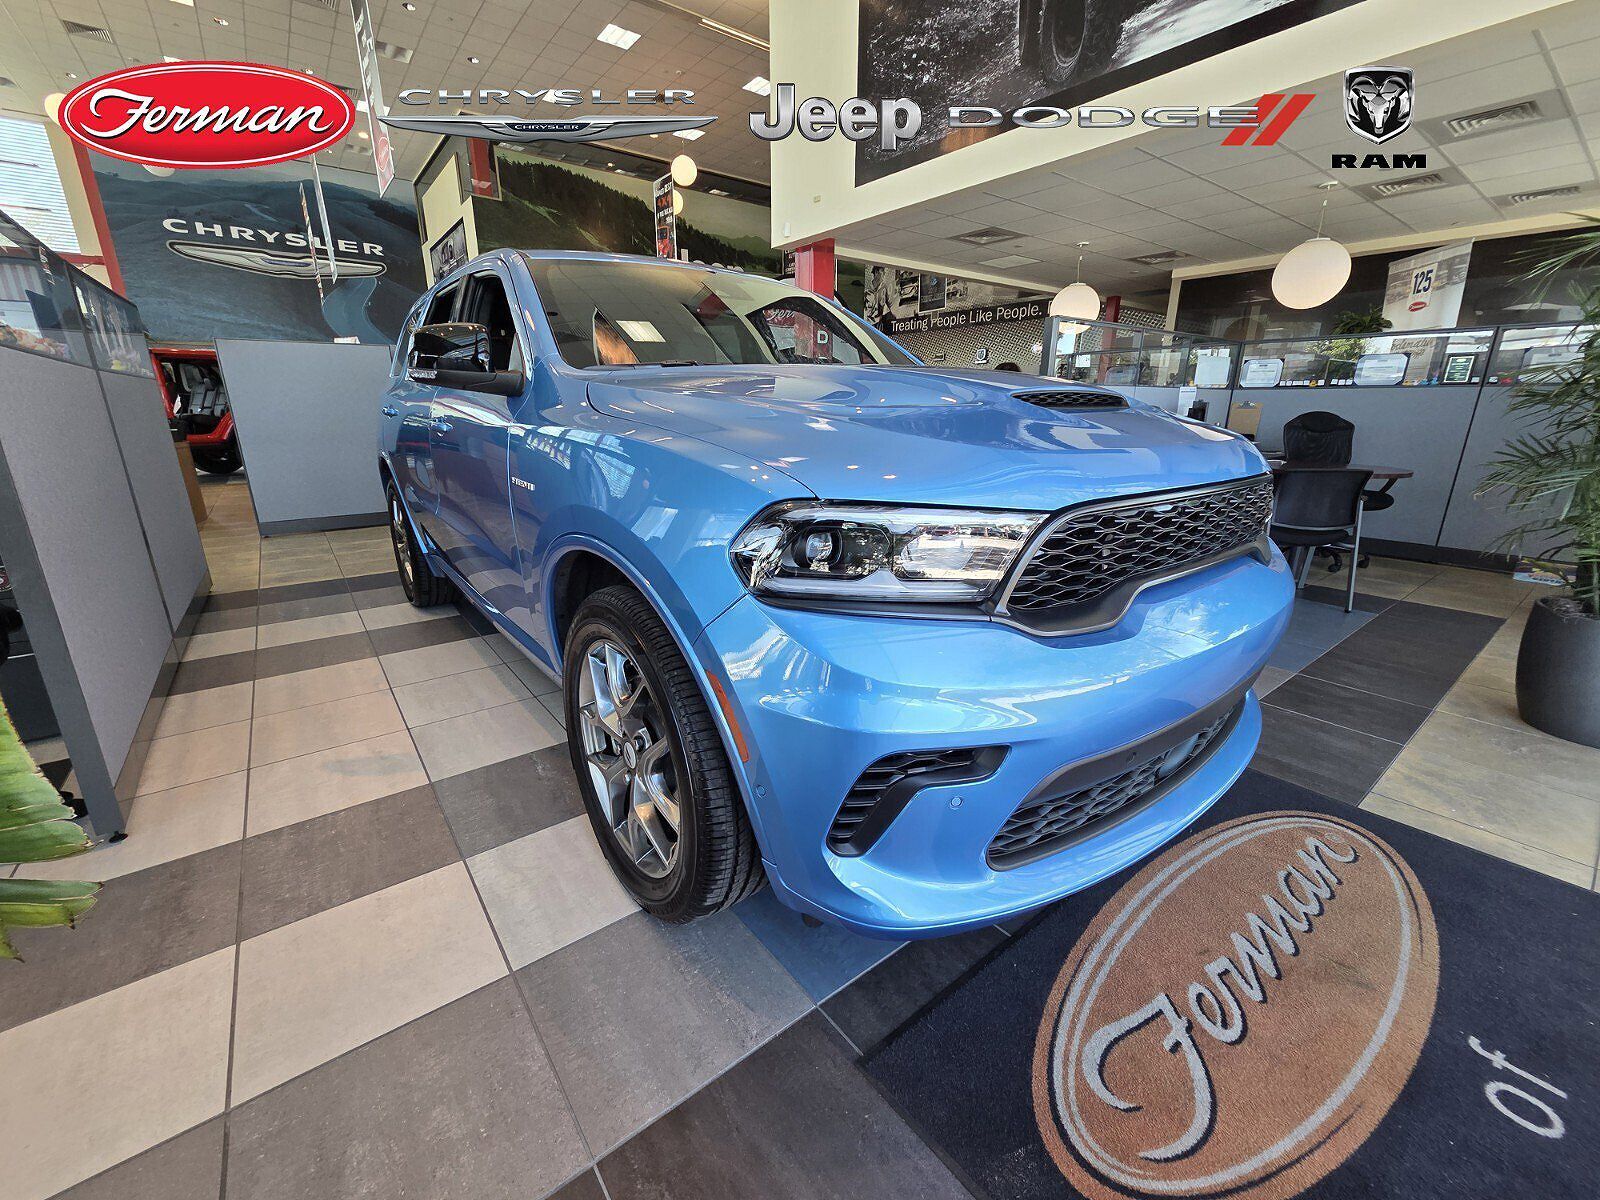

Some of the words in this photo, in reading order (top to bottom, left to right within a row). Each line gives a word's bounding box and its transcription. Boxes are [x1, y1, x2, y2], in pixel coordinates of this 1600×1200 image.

[162, 218, 384, 256] CHRYSLER
[1412, 268, 1434, 295] 125
[891, 317, 929, 332] Treating
[969, 309, 993, 324] Like
[996, 302, 1042, 321] People.
[1082, 835, 1359, 1162] Ferman
